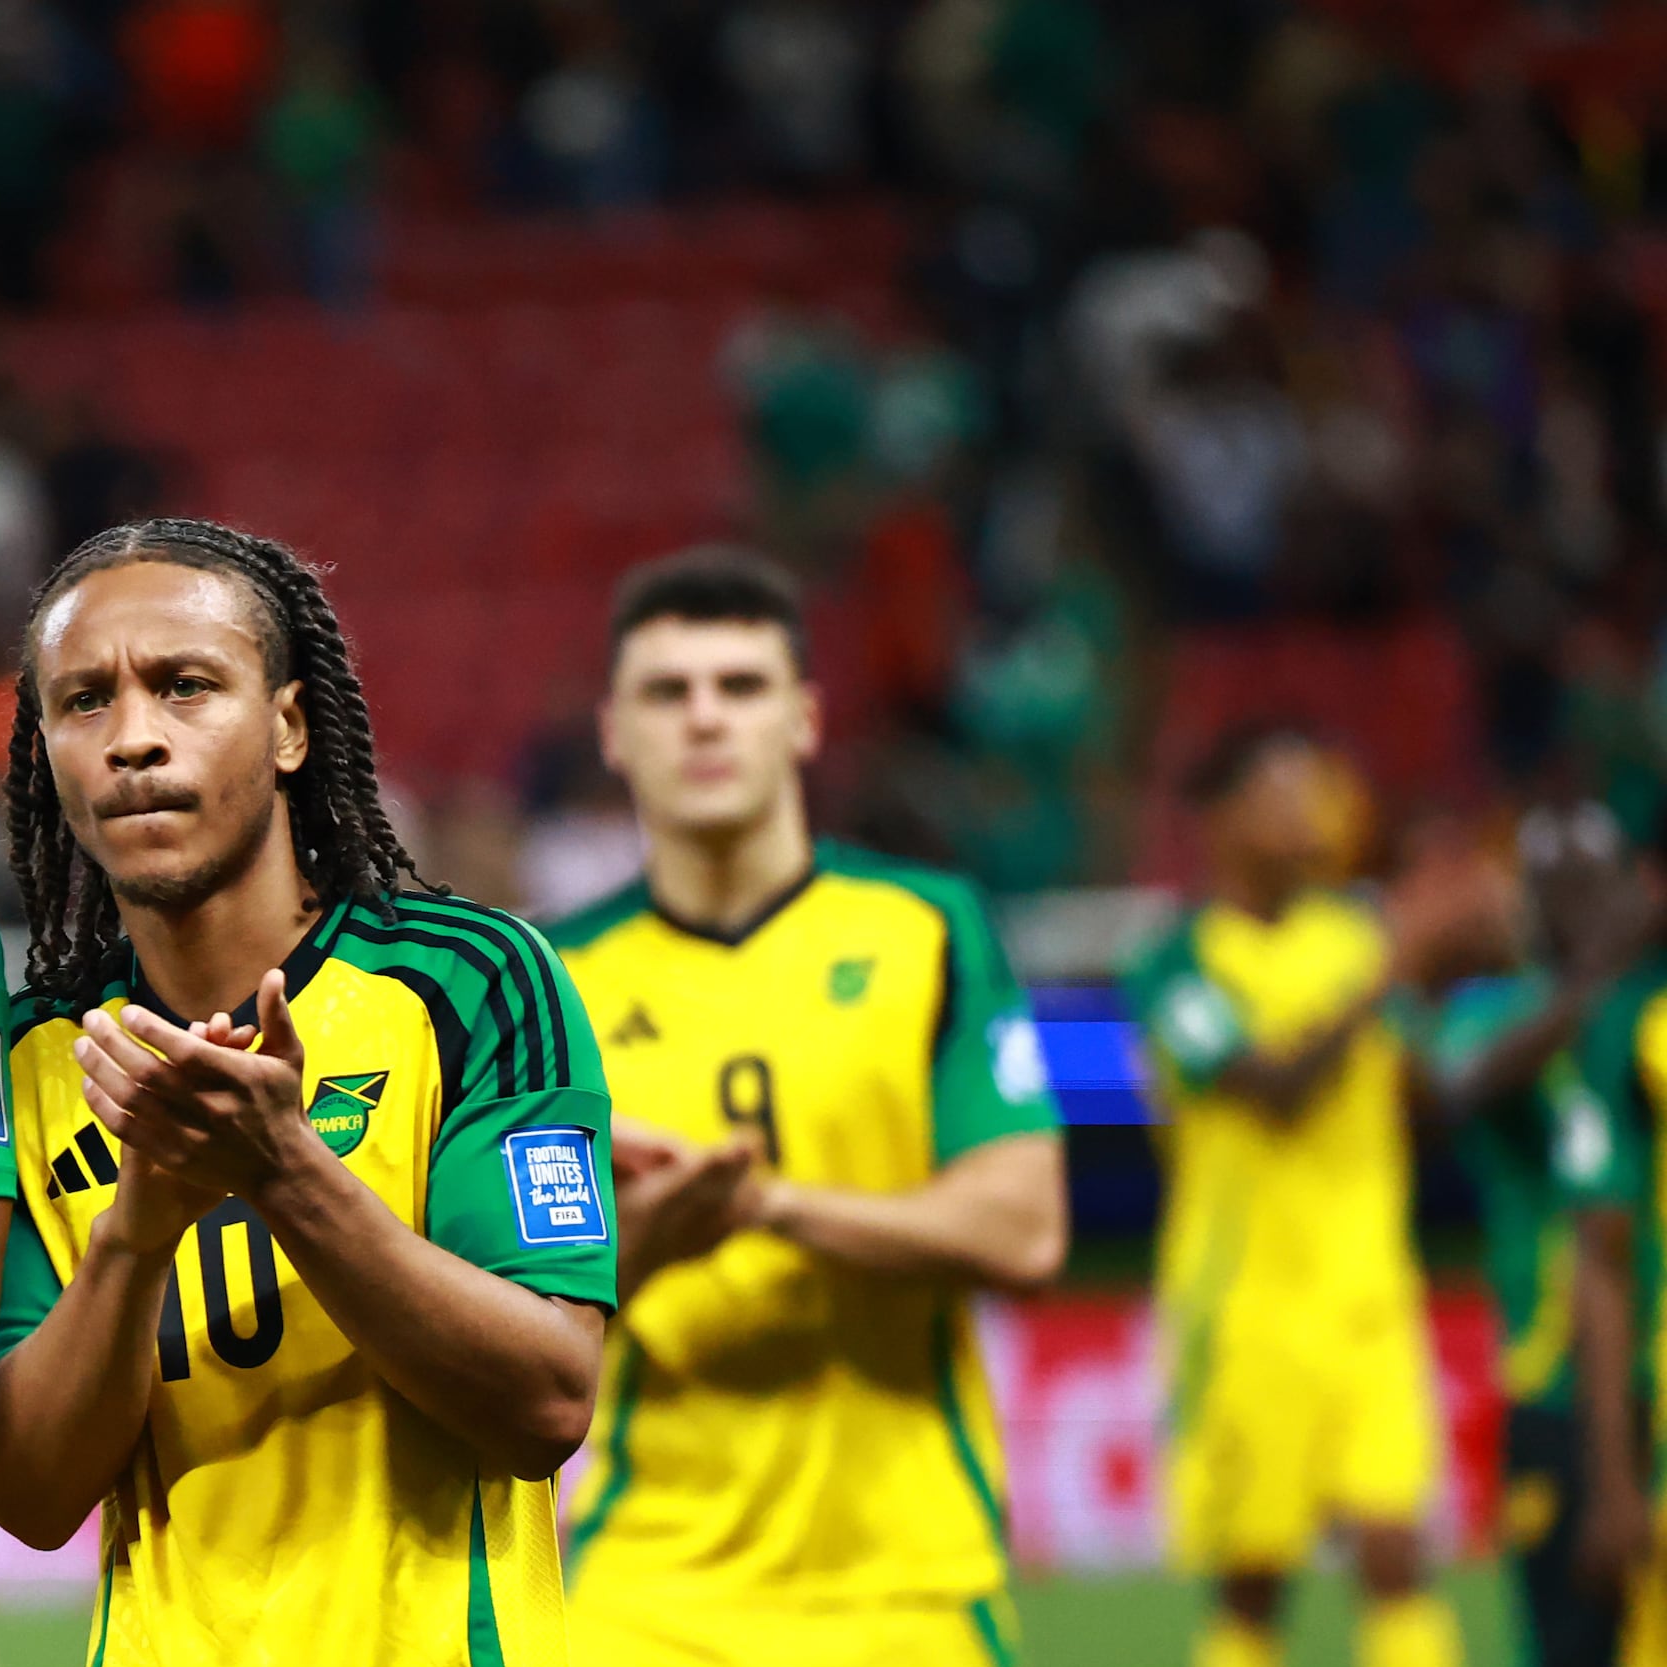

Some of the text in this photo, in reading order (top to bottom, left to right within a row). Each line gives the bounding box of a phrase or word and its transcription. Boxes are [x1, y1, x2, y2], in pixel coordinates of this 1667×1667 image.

[719, 1054, 782, 1168] 9
[525, 1146, 579, 1163] FOOTBALL
[528, 1163, 584, 1186] UNITES
[529, 1184, 591, 1206] the World
[555, 1211, 578, 1220] FIFA
